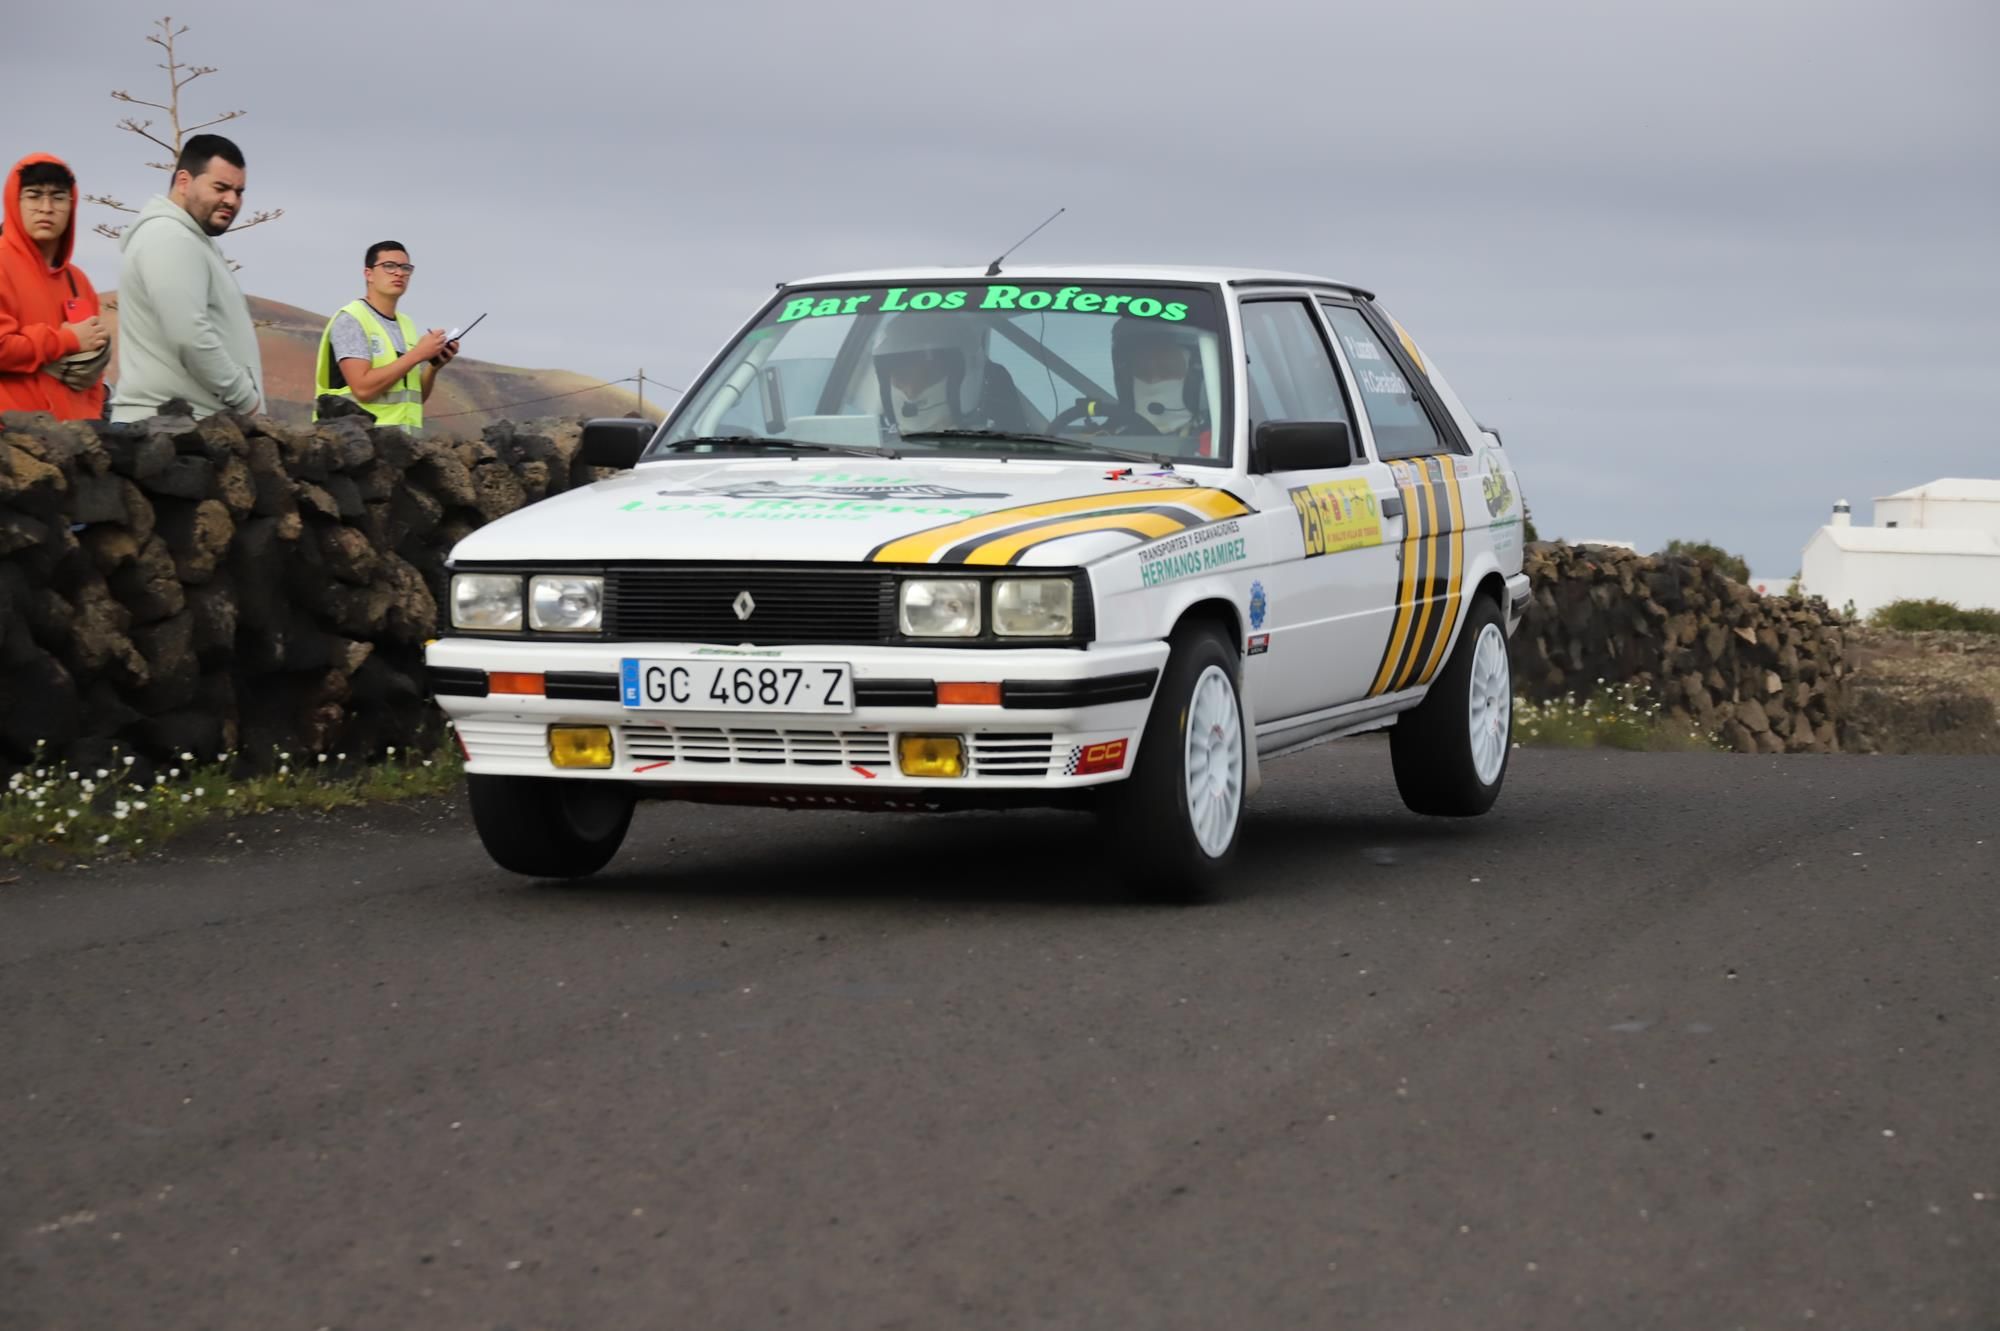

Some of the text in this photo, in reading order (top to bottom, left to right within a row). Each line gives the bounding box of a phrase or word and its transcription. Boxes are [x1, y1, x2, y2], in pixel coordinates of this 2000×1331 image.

[778, 286, 1189, 324] Bar Los Roferos
[617, 499, 714, 513] Los
[1138, 521, 1240, 563] TRANSPORTES Y EXCAVACIONES
[1140, 538, 1247, 587] HERMANOS RAMIREZ
[626, 687, 636, 700] E
[646, 666, 844, 706] GC 4687 Z
